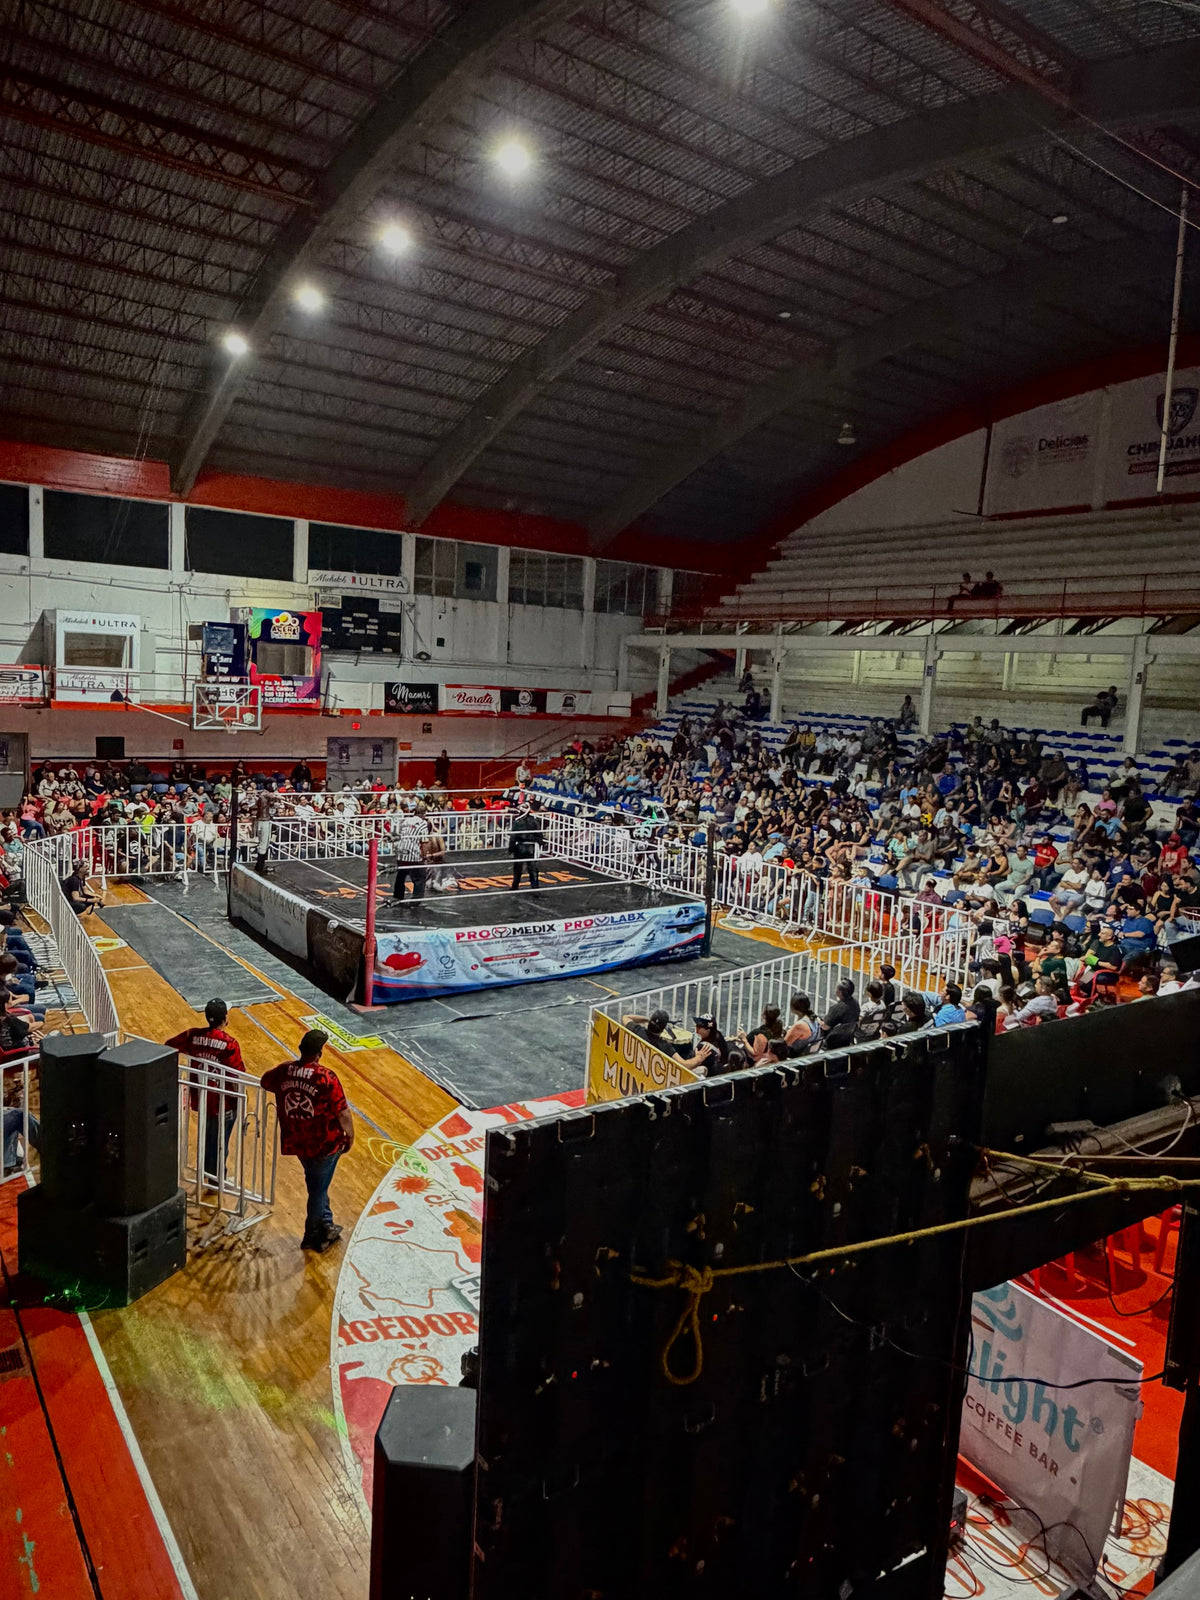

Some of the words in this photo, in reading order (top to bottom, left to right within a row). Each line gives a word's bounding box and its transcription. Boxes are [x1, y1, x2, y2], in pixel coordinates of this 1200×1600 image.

[359, 577, 405, 589] ULTRA
[98, 619, 137, 629] ULTRA
[60, 680, 106, 689] ULTRA
[455, 929, 491, 942] PRO
[511, 923, 557, 936] MEDIX
[563, 918, 594, 932] PRO
[609, 911, 647, 924] LABX
[606, 1020, 681, 1089] MUNCH
[287, 1064, 315, 1080] STAFF
[969, 1340, 1086, 1453] light
[964, 1394, 1023, 1448] COFFEE
[1029, 1441, 1060, 1478] BAR
